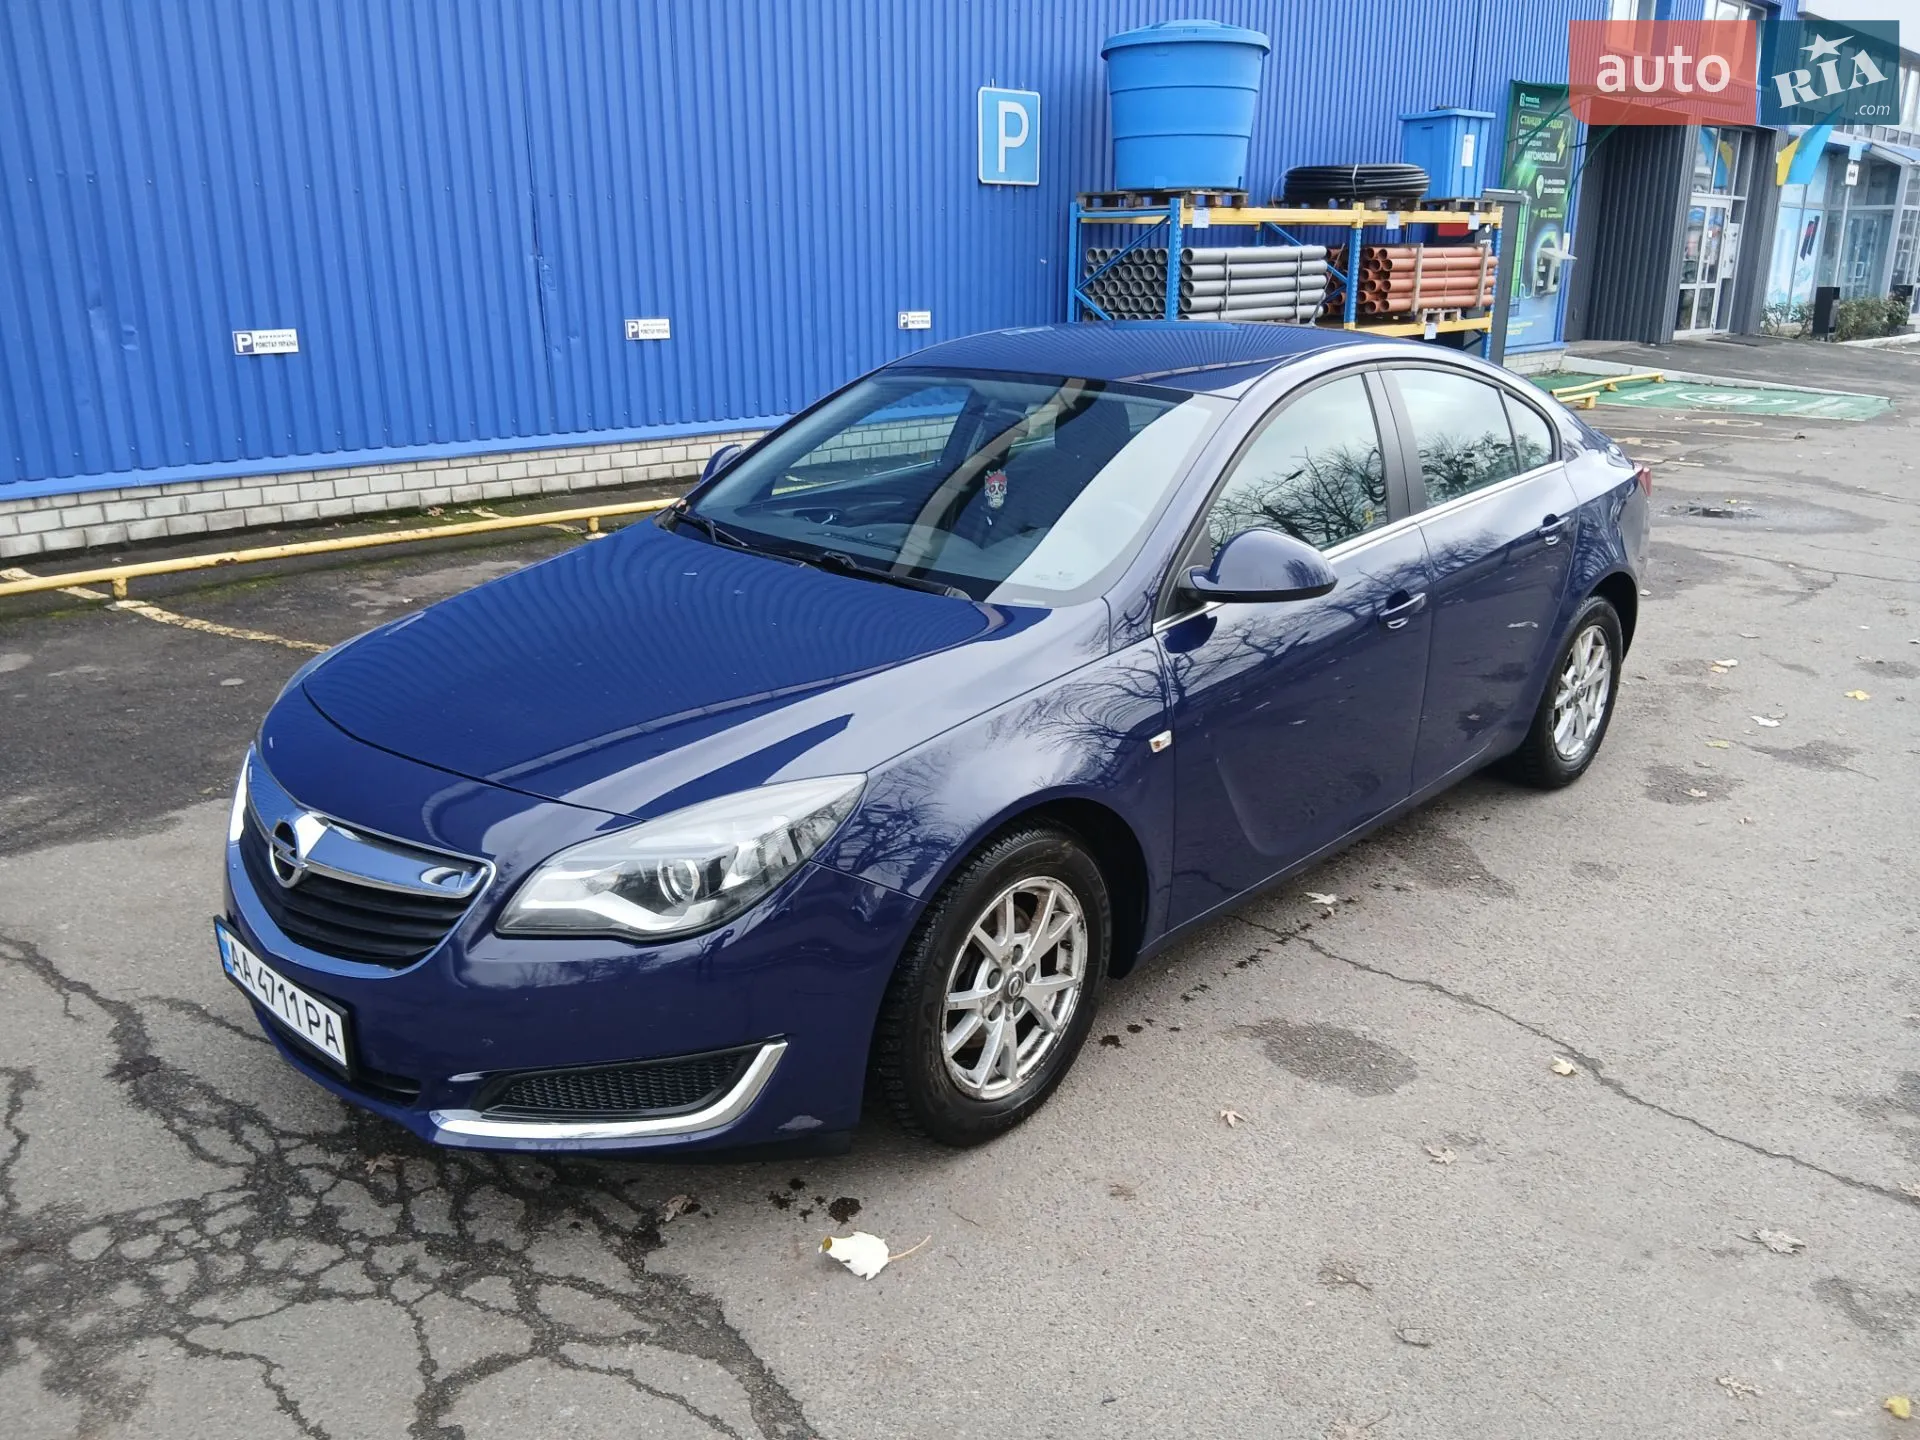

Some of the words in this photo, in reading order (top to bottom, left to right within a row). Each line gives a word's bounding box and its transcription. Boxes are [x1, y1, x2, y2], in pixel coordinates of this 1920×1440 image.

[998, 101, 1029, 172] P
[237, 333, 252, 352] P
[628, 322, 638, 338] P
[231, 941, 255, 990] AA
[258, 966, 302, 1028] 4711
[304, 1000, 341, 1054] PA
